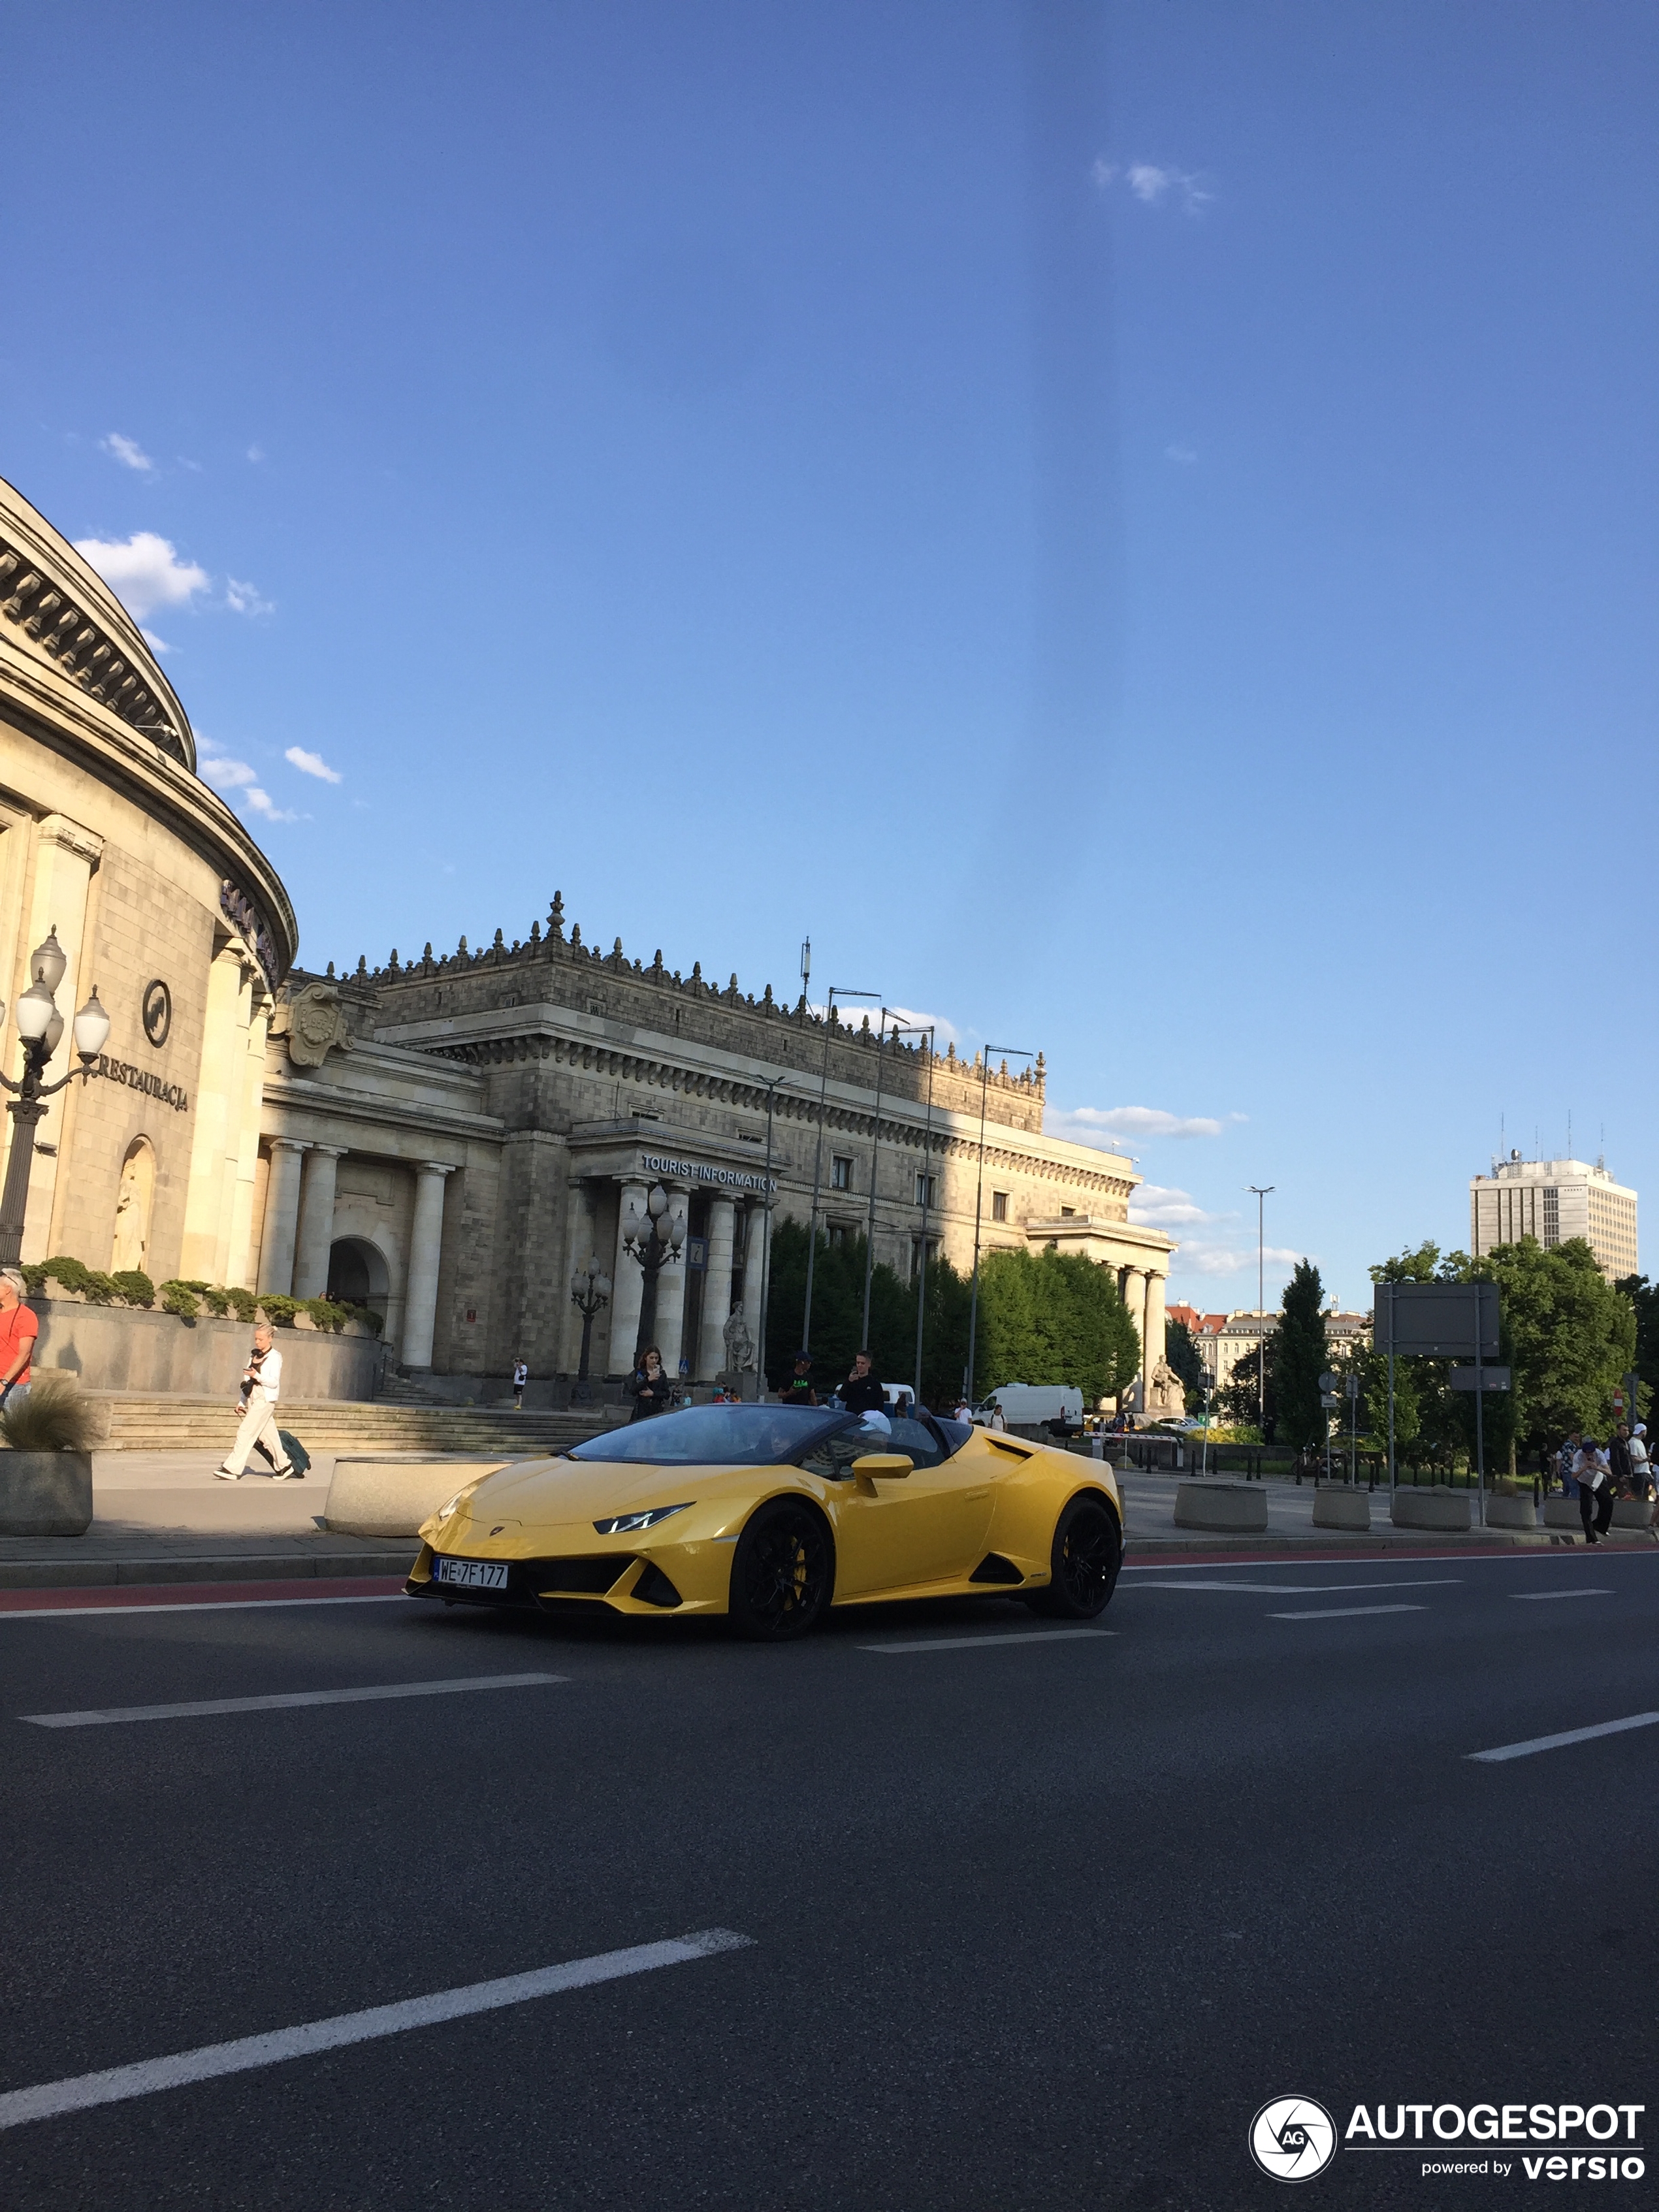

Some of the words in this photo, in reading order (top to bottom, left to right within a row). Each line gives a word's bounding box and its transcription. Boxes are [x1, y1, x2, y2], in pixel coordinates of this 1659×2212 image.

[99, 1053, 188, 1112] RESTAURACJA
[643, 1154, 696, 1178] TOURIST
[698, 1165, 777, 1193] INFORMATION
[441, 1560, 457, 1581] WE
[460, 1563, 505, 1586] 7F177
